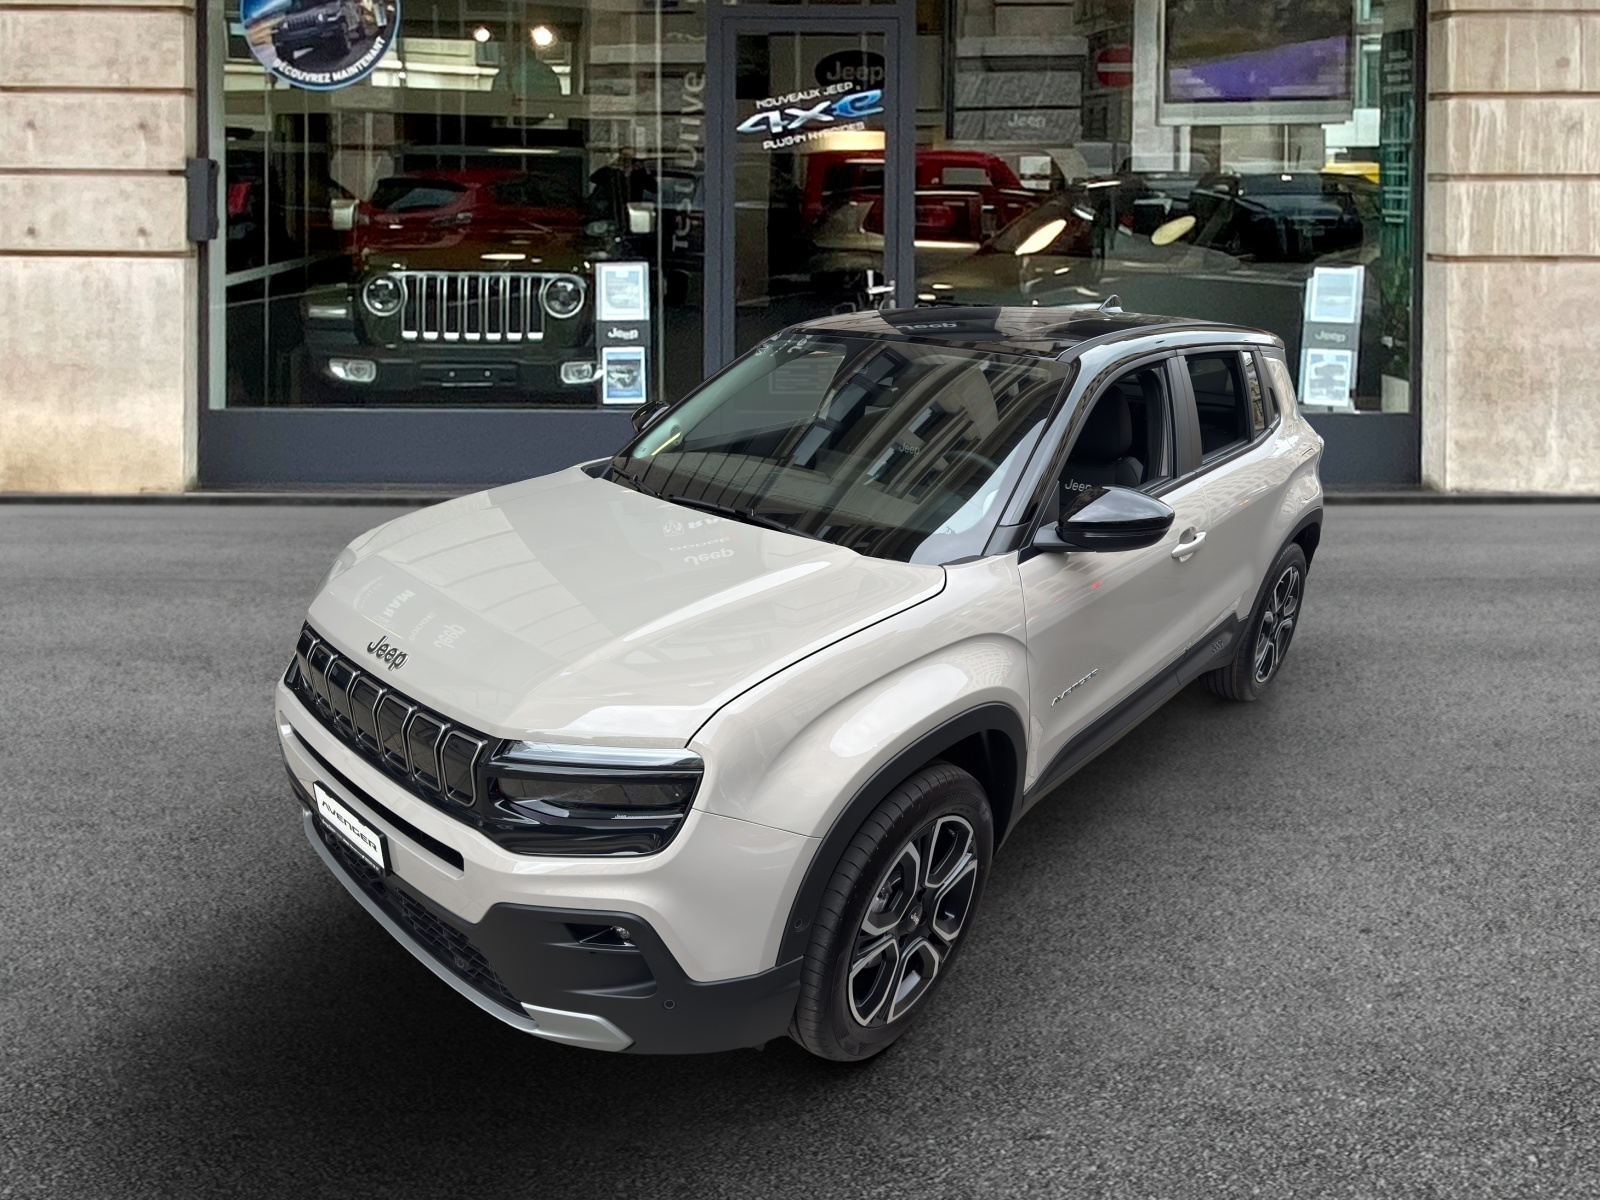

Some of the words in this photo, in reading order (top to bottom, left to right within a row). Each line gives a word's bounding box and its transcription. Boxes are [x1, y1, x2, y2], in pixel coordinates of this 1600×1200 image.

[332, 36, 386, 81] MAINTENANT
[826, 61, 884, 85] Jeep
[755, 88, 822, 110] NOUVEAUX
[823, 81, 854, 96] JEEP
[607, 327, 639, 340] Jeep
[1314, 330, 1347, 343] Jeep
[898, 442, 920, 457] Jeep
[366, 635, 409, 672] Jeep
[321, 800, 379, 853] AVENGER
